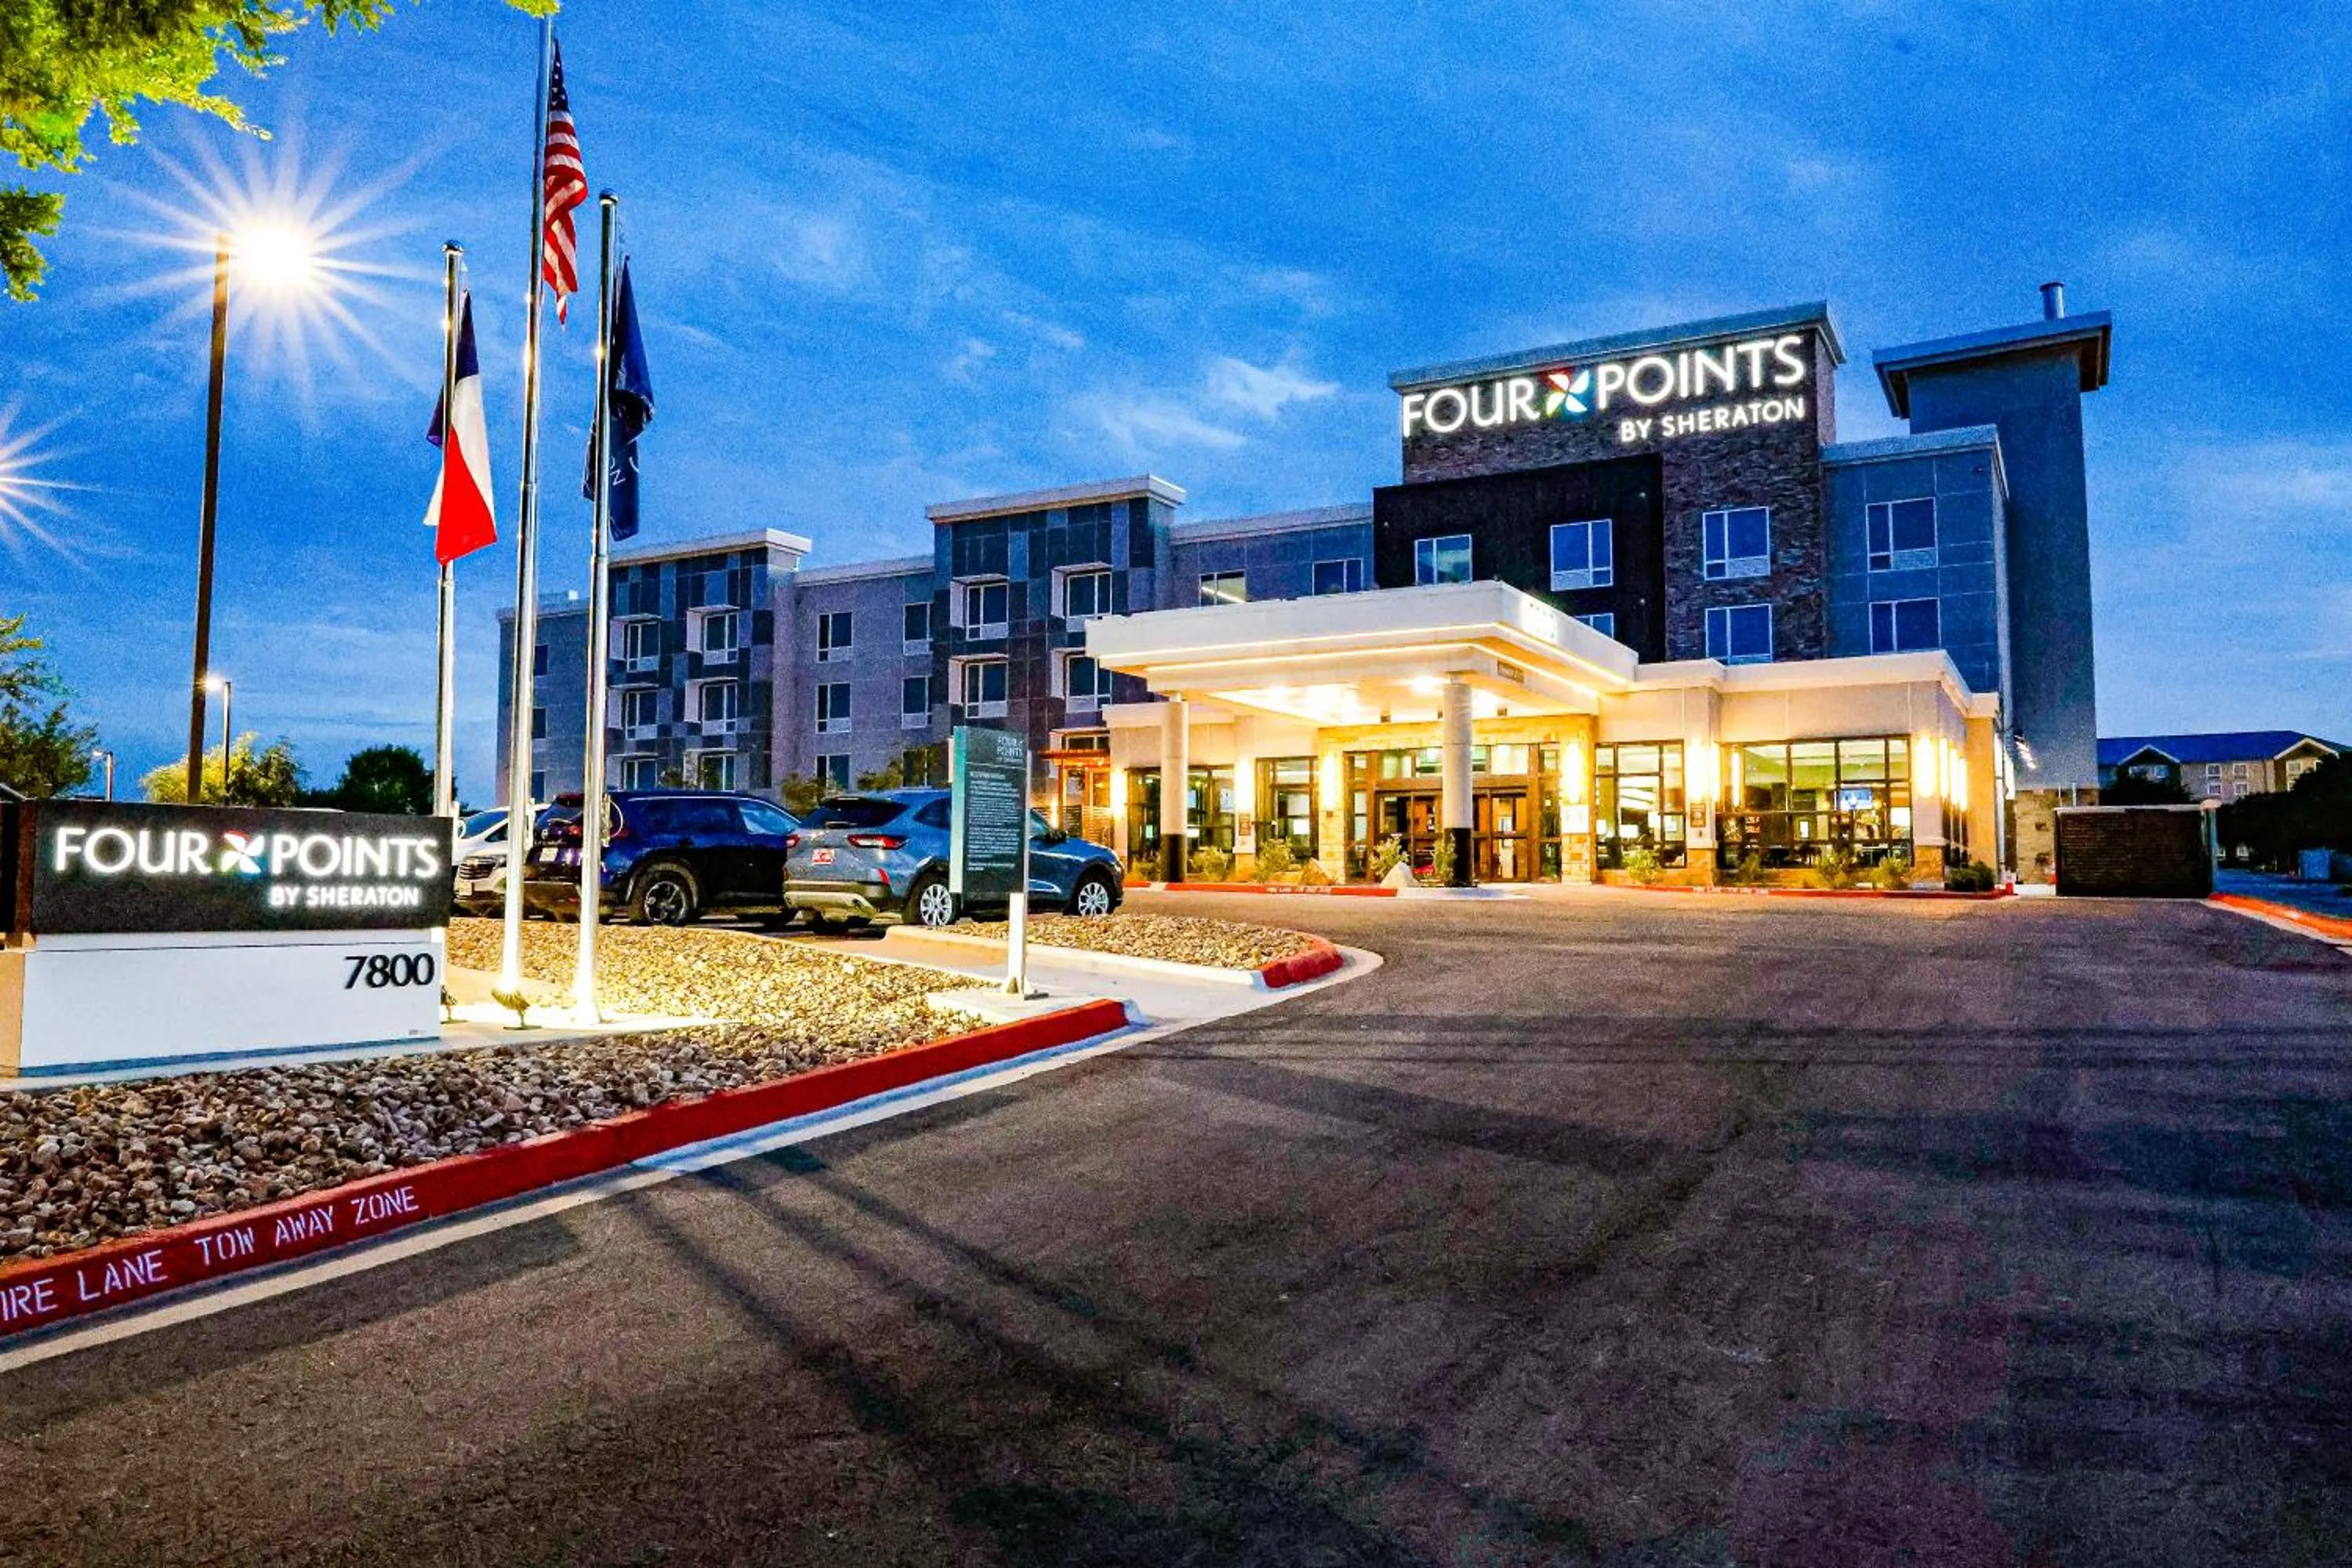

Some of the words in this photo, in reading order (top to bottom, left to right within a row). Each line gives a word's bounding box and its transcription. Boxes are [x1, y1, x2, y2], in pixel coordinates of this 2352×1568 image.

[1401, 378, 1541, 437] FOUR
[1596, 336, 1805, 409] POINTS
[1620, 418, 1652, 442] BY
[1661, 397, 1805, 437] SHERATON
[55, 827, 212, 875] FOUR
[270, 833, 439, 879] POINTS
[269, 885, 298, 907] BY
[306, 885, 420, 907] SHERATON
[344, 952, 435, 989] 7800
[0, 1278, 59, 1321] IRE
[77, 1249, 169, 1301] LANE
[194, 1228, 255, 1265] TOW
[274, 1205, 335, 1247] AWAY
[351, 1185, 419, 1225] ZONE
